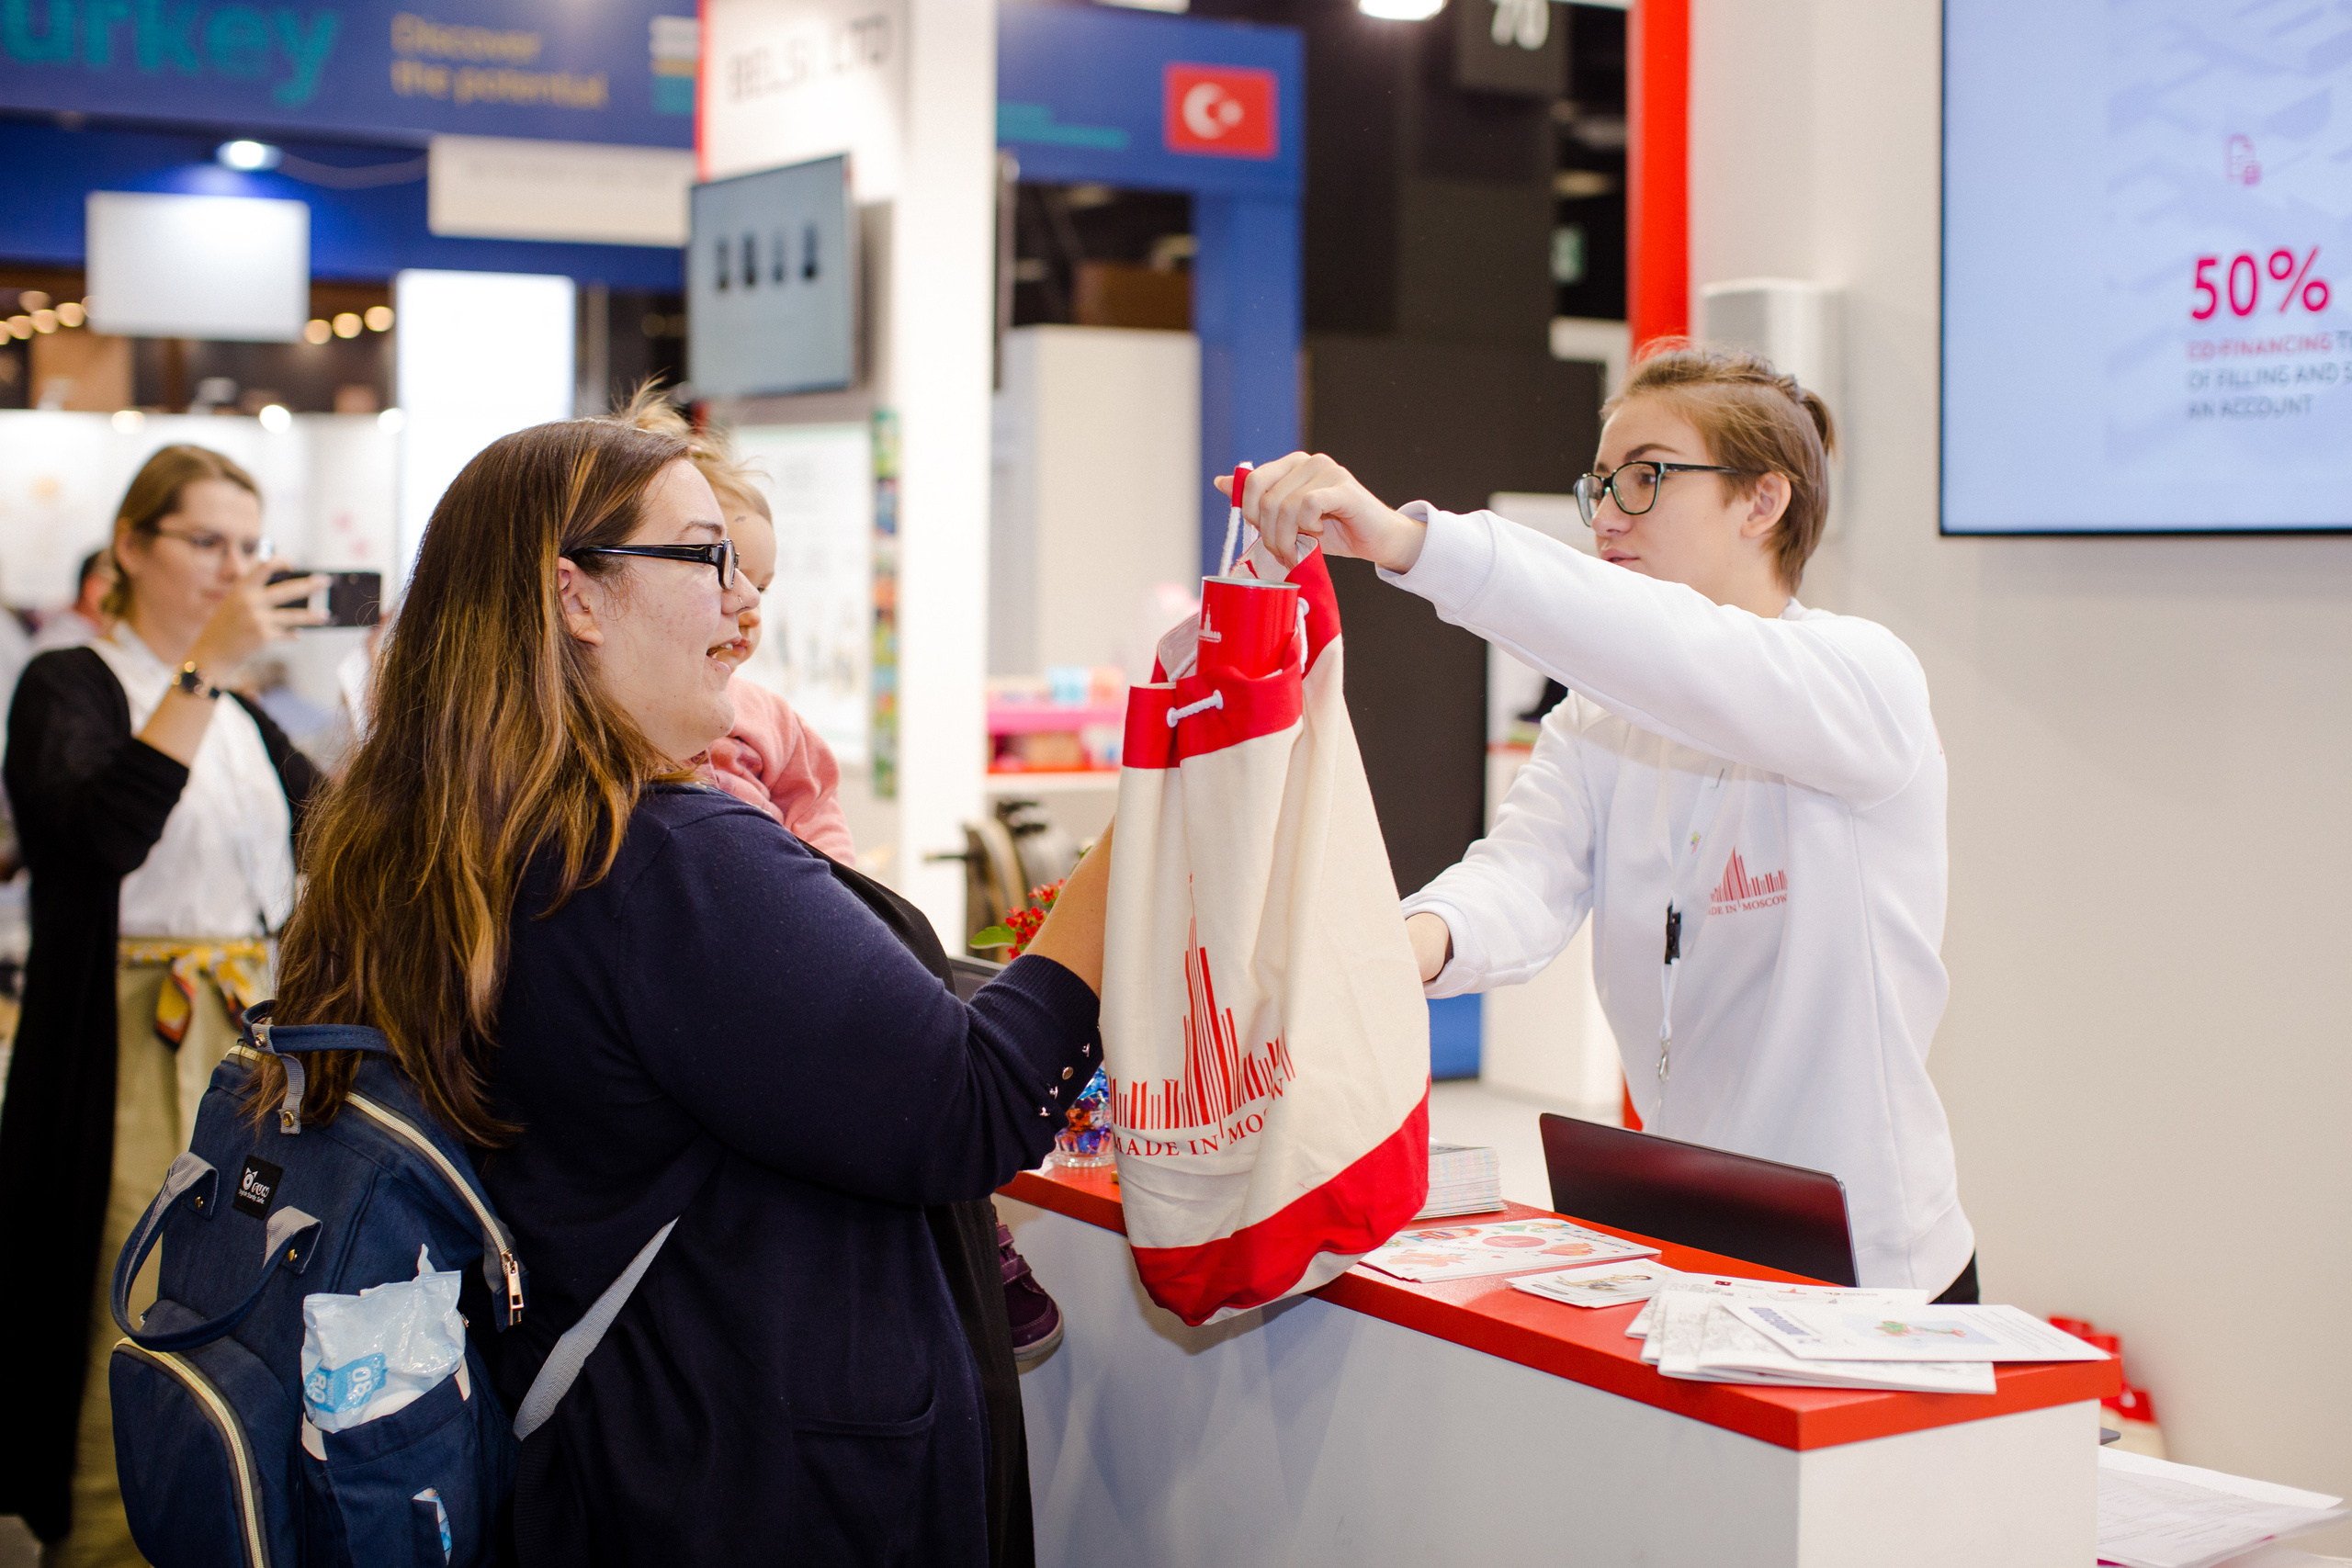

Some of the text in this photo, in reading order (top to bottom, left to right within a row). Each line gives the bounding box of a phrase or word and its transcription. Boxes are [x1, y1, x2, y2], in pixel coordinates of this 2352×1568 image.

[390, 59, 450, 99] the
[2191, 245, 2330, 321] 50%
[2187, 330, 2352, 362] CO-FINANCING T
[2188, 369, 2211, 391] OF
[2217, 366, 2290, 388] FILLING
[2296, 362, 2340, 385] AND
[2188, 394, 2314, 419] AN ACCOUNT
[1725, 904, 1737, 914] IN
[1742, 894, 1787, 911] MOSCOW
[1114, 1134, 1181, 1156] MADE
[1188, 1134, 1219, 1156] IN
[352, 1365, 373, 1397] 80
